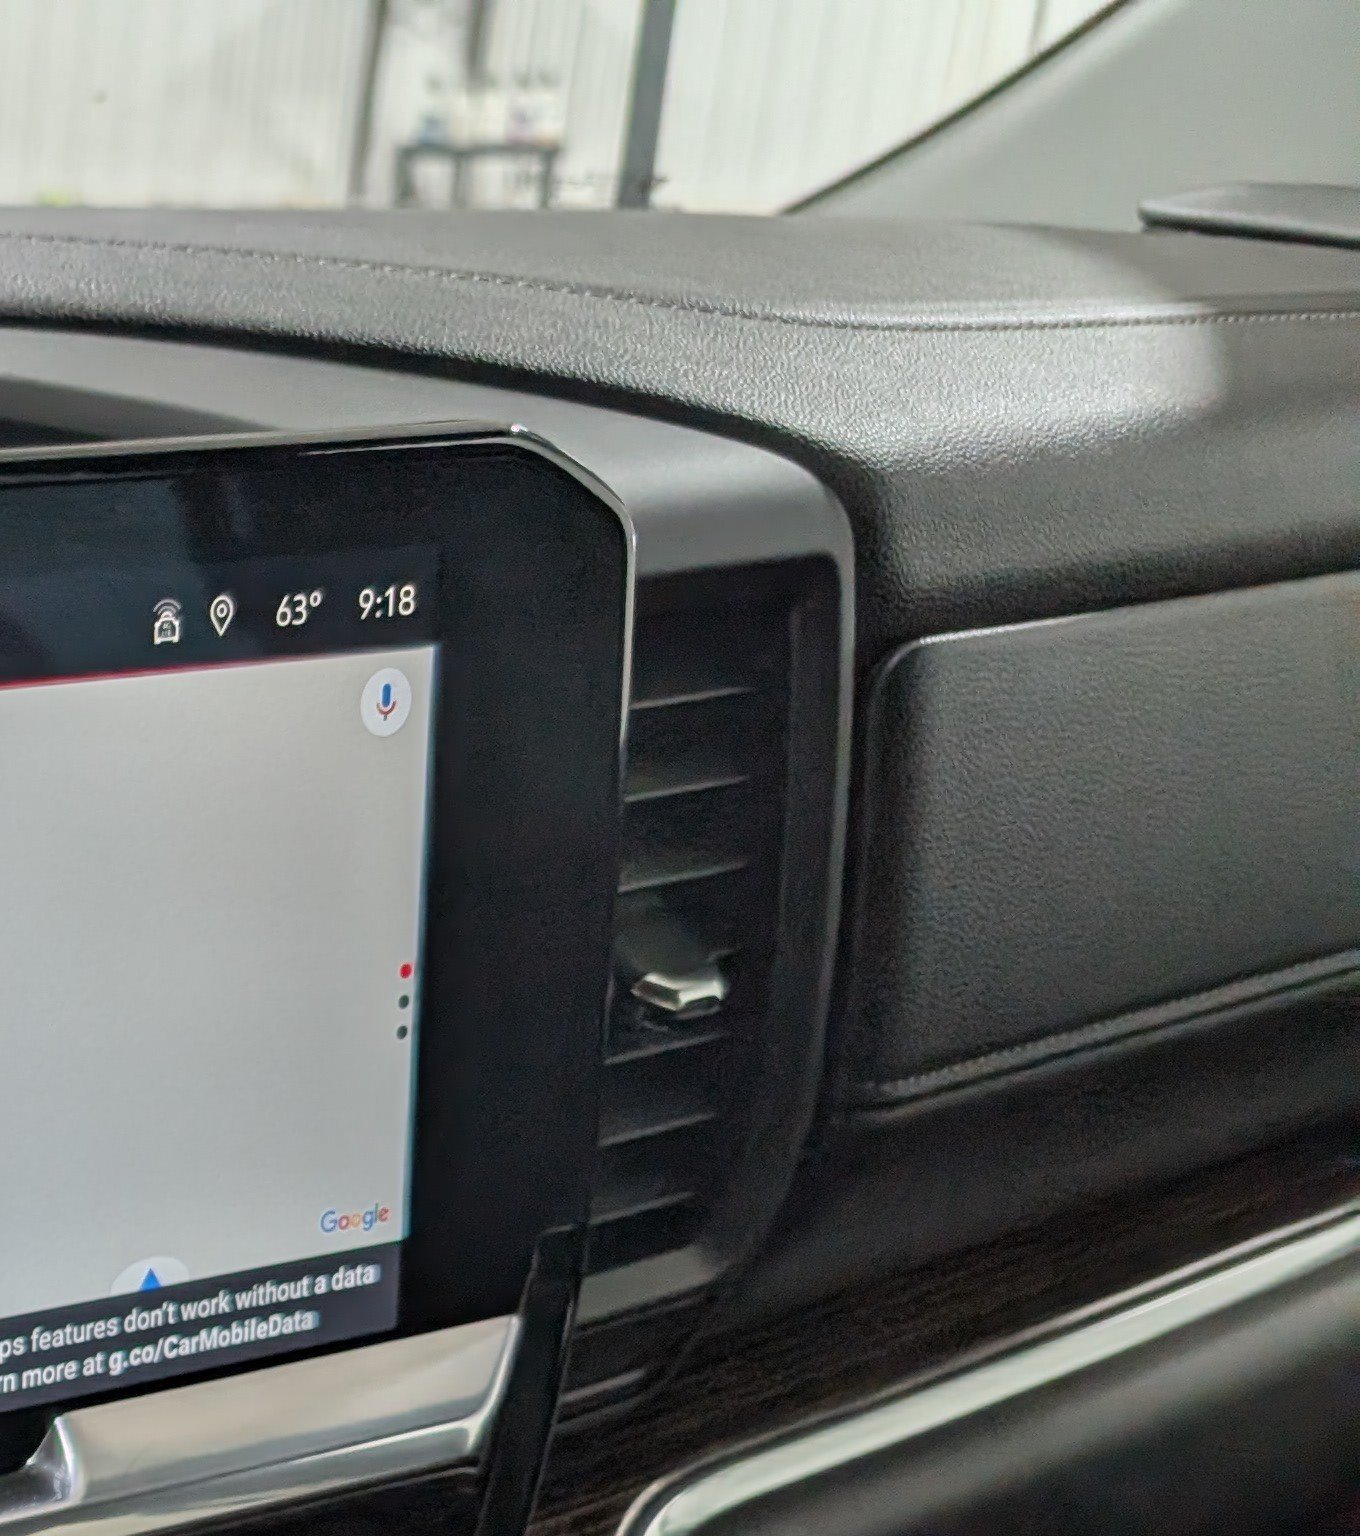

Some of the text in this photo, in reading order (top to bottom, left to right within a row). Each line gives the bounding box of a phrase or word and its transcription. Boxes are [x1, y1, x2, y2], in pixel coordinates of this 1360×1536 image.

[357, 584, 418, 621] 9:18
[319, 1203, 390, 1234] Google
[30, 1316, 119, 1353] features
[181, 1290, 231, 1323] work
[235, 1275, 310, 1311] without
[314, 1278, 327, 1296] a
[330, 1263, 379, 1292] data
[21, 1361, 77, 1391] more
[82, 1352, 105, 1378] at
[108, 1310, 318, 1378] g.co/CarMobileData
